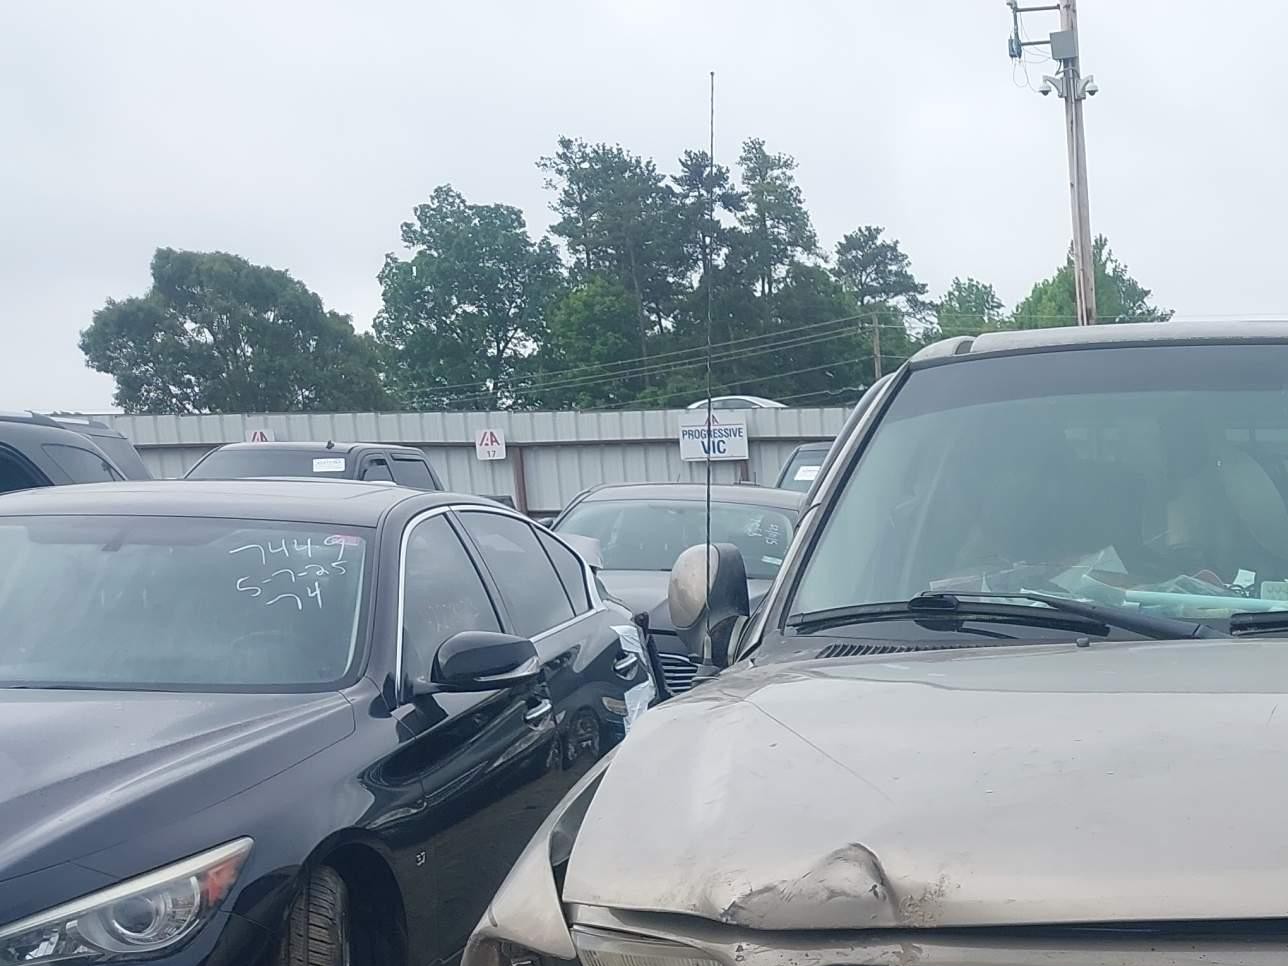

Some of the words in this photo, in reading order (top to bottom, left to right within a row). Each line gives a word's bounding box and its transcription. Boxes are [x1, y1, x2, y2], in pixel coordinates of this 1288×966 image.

[487, 450, 496, 458] 17
[701, 440, 727, 454] VIC
[229, 535, 346, 565] 7449
[236, 560, 347, 597] 5-7-25
[266, 581, 322, 610] 74
